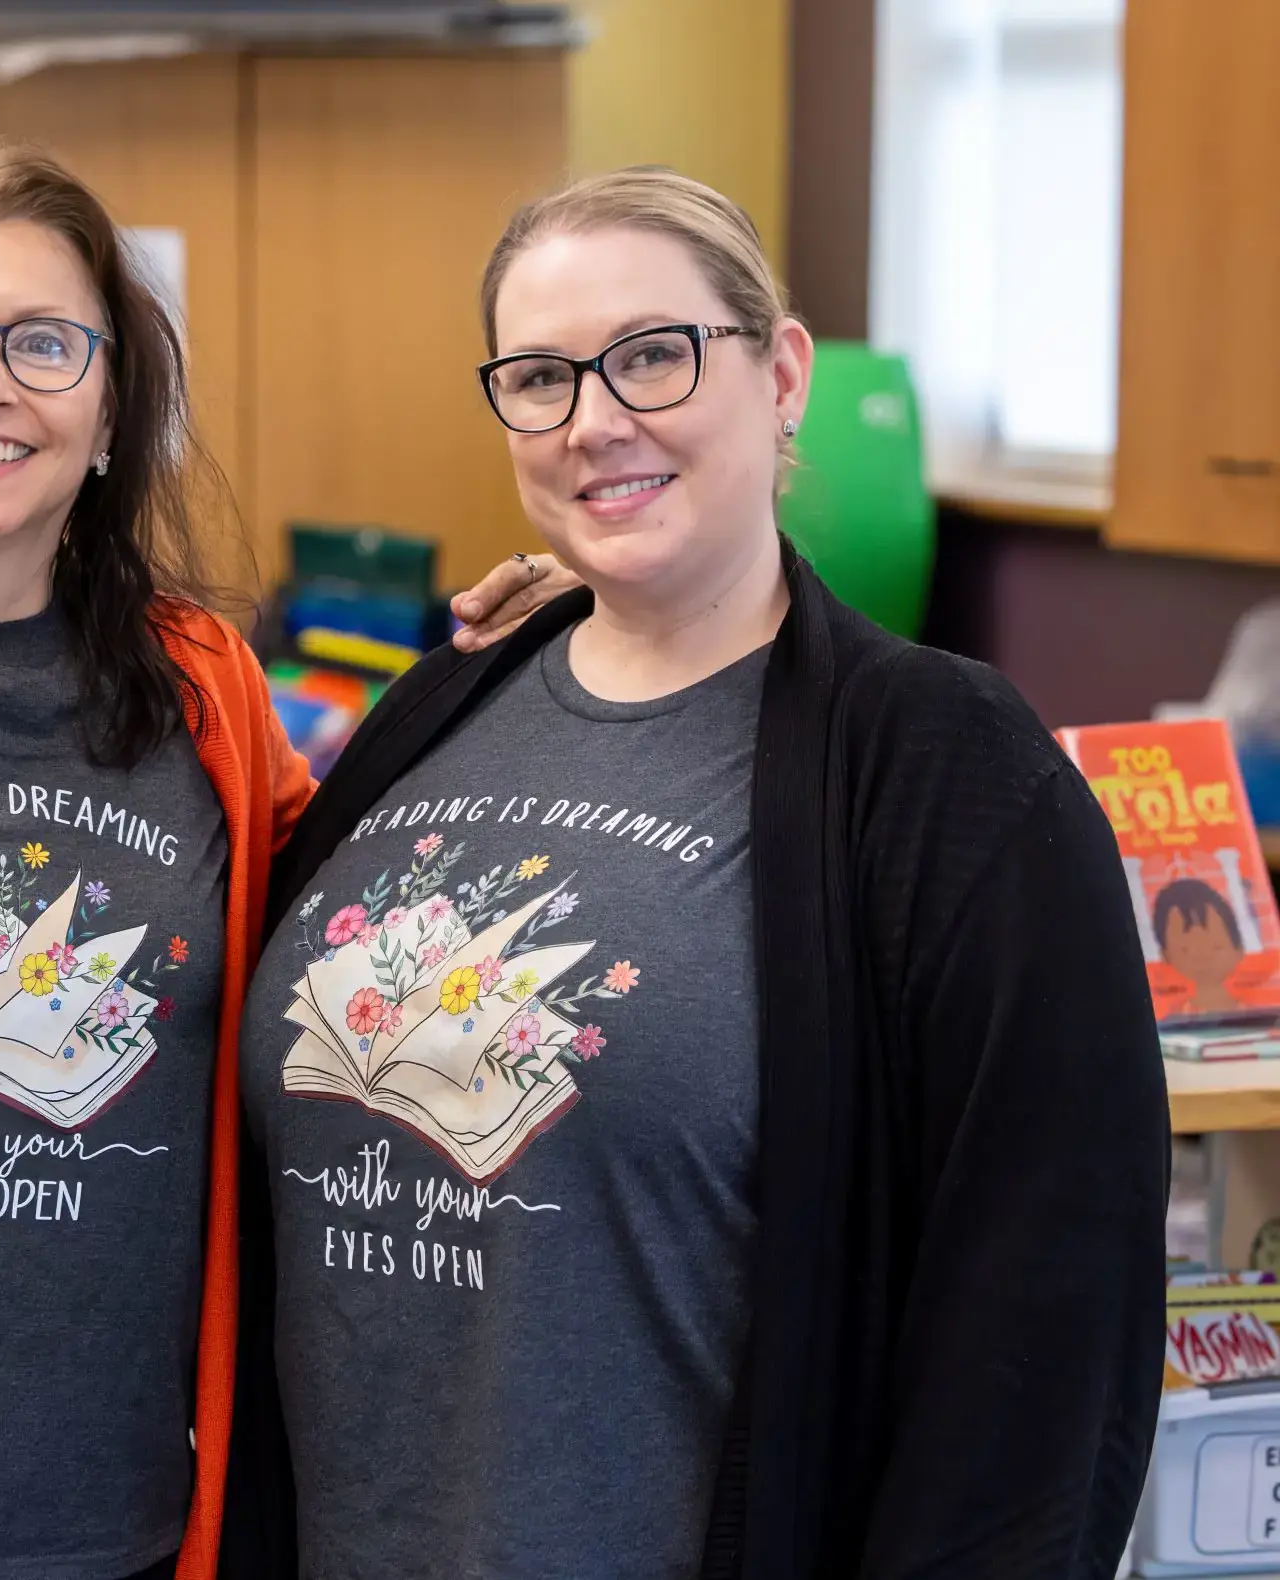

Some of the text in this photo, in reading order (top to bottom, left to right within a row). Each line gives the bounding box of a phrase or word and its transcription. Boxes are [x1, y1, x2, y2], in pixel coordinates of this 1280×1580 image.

[8, 783, 179, 866] DREAMING
[350, 796, 716, 863] READING IS DREAMING
[1090, 767, 1236, 831] Tola
[0, 1130, 100, 1177] your
[313, 1139, 504, 1231] with your
[325, 1226, 483, 1290] EYES OPEN
